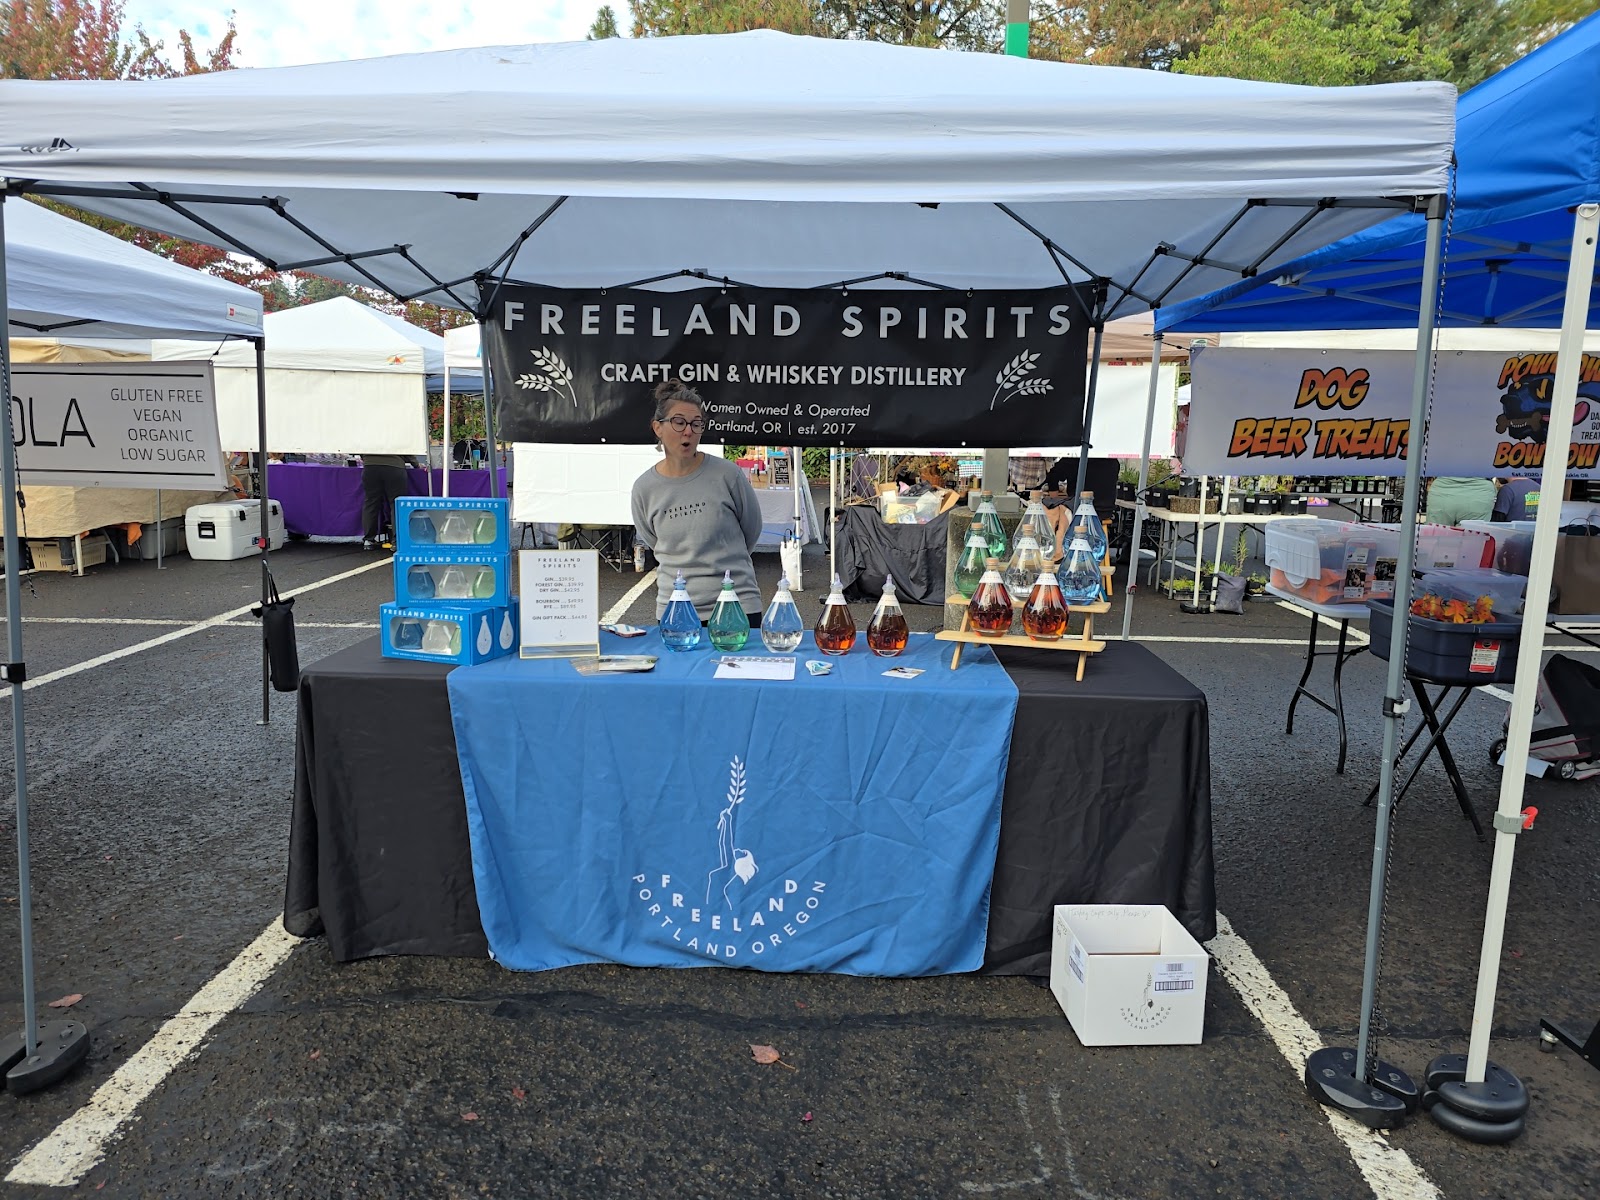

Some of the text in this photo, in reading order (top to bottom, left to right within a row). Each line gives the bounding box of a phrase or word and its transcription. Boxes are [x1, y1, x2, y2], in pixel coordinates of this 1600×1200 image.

[503, 301, 1072, 339] FREELAND SPIRITS
[601, 363, 967, 386] CRAFT GIN & WHISKEY DISTILLERY
[110, 388, 204, 403] GLUTEN FREE
[1293, 366, 1371, 411] DOG
[133, 408, 182, 422] VEGAN
[701, 400, 871, 420] Women Owned & Operated
[128, 428, 194, 442] ORGANIC
[708, 419, 759, 435] Portland,
[762, 421, 782, 434] OR
[797, 424, 818, 435] est.
[822, 422, 857, 435] 2017
[1227, 416, 1313, 460] BEER
[120, 447, 206, 463] LOW SUGAR
[664, 502, 706, 515] FREELAND
[669, 508, 702, 519] SPIRITS
[383, 608, 464, 622] FREELAND SPIRITS
[661, 874, 798, 932] FREELAND
[632, 873, 826, 958] PORTLAND OREGON
[1120, 1008, 1148, 1030] PORTLAND
[1127, 1007, 1164, 1023] FREELAND
